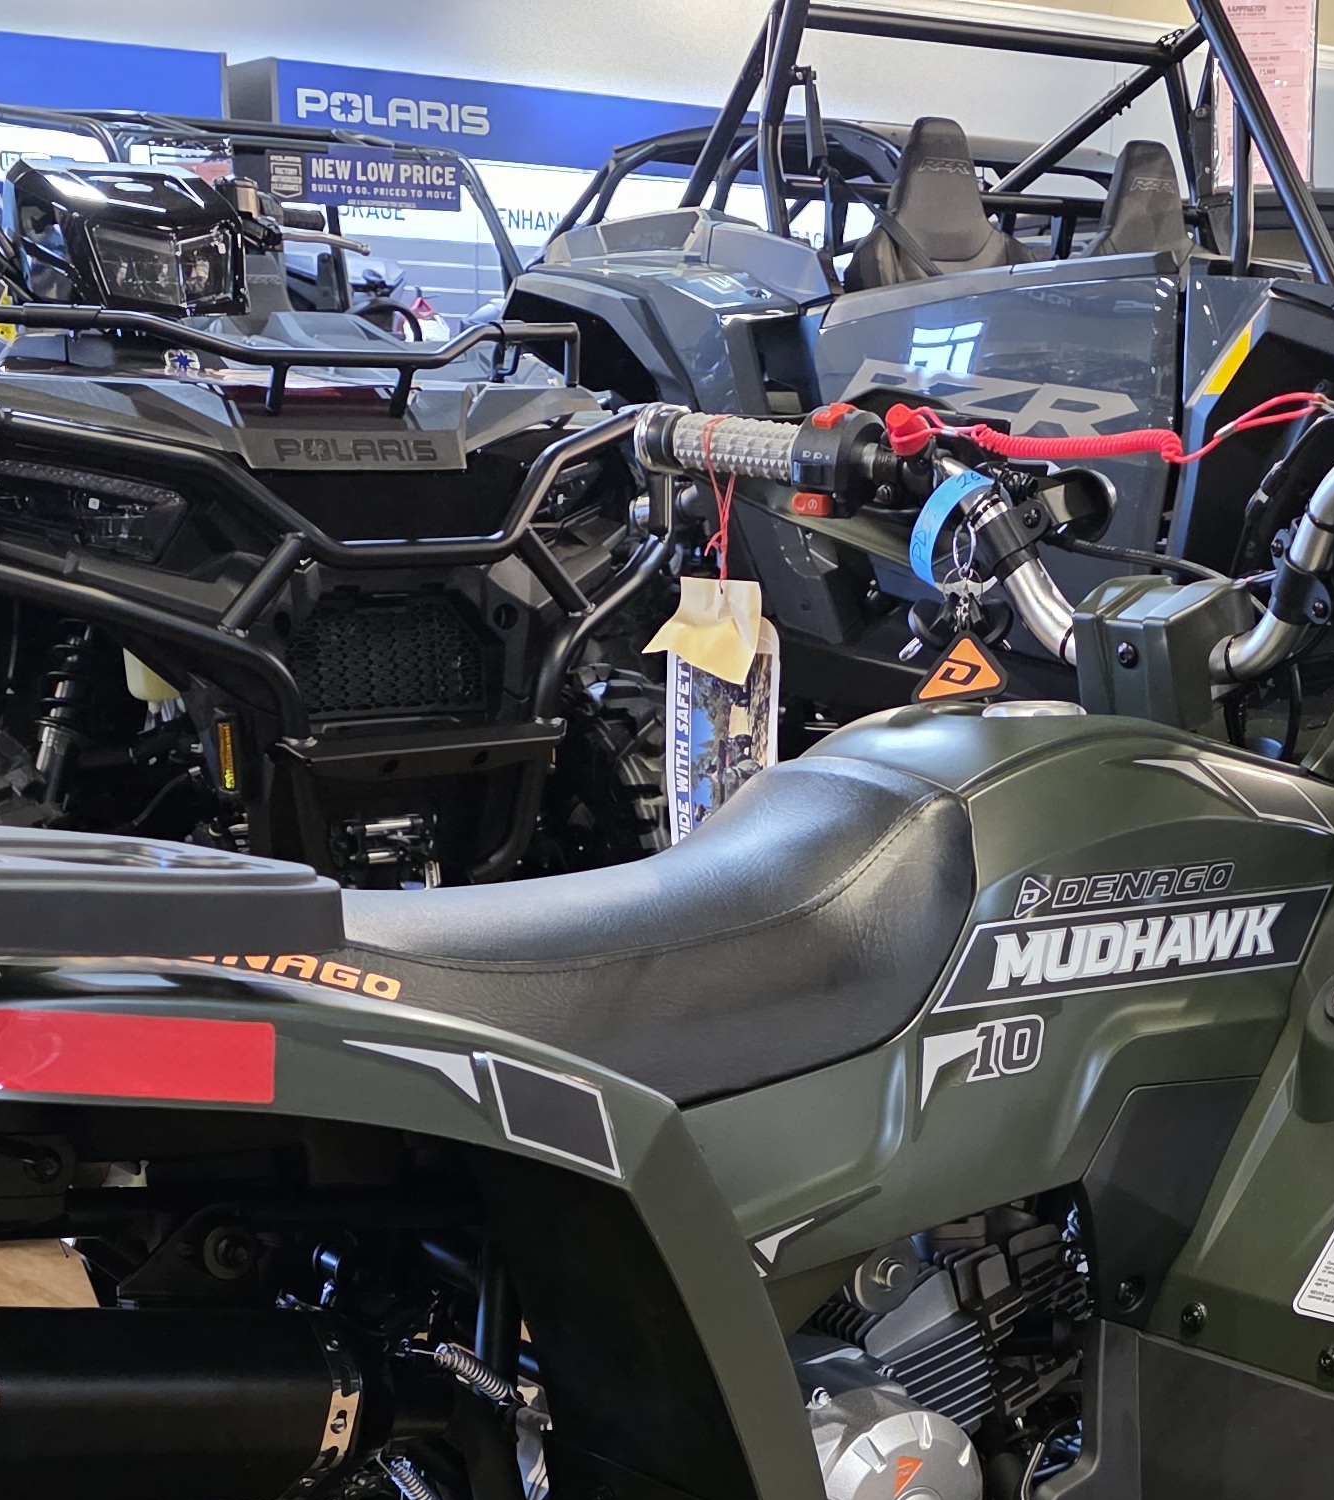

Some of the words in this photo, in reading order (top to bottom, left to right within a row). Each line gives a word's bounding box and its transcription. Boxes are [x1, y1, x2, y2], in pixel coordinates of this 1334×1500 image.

[296, 88, 490, 136] POLARIS
[311, 158, 352, 180] NEW
[356, 161, 395, 184] LOW
[399, 164, 457, 187] PRICE
[918, 156, 971, 175] RZR
[311, 183, 338, 193] BUILT
[340, 184, 352, 194] TO
[373, 187, 407, 197] PRICED
[410, 189, 423, 198] TO
[1130, 176, 1175, 194] RZR
[273, 438, 438, 462] POLARIS
[676, 739, 689, 793] WITH
[1052, 862, 1235, 908] DENAGO
[987, 903, 1286, 991] MUDHAWK
[966, 1014, 1046, 1083] 10
